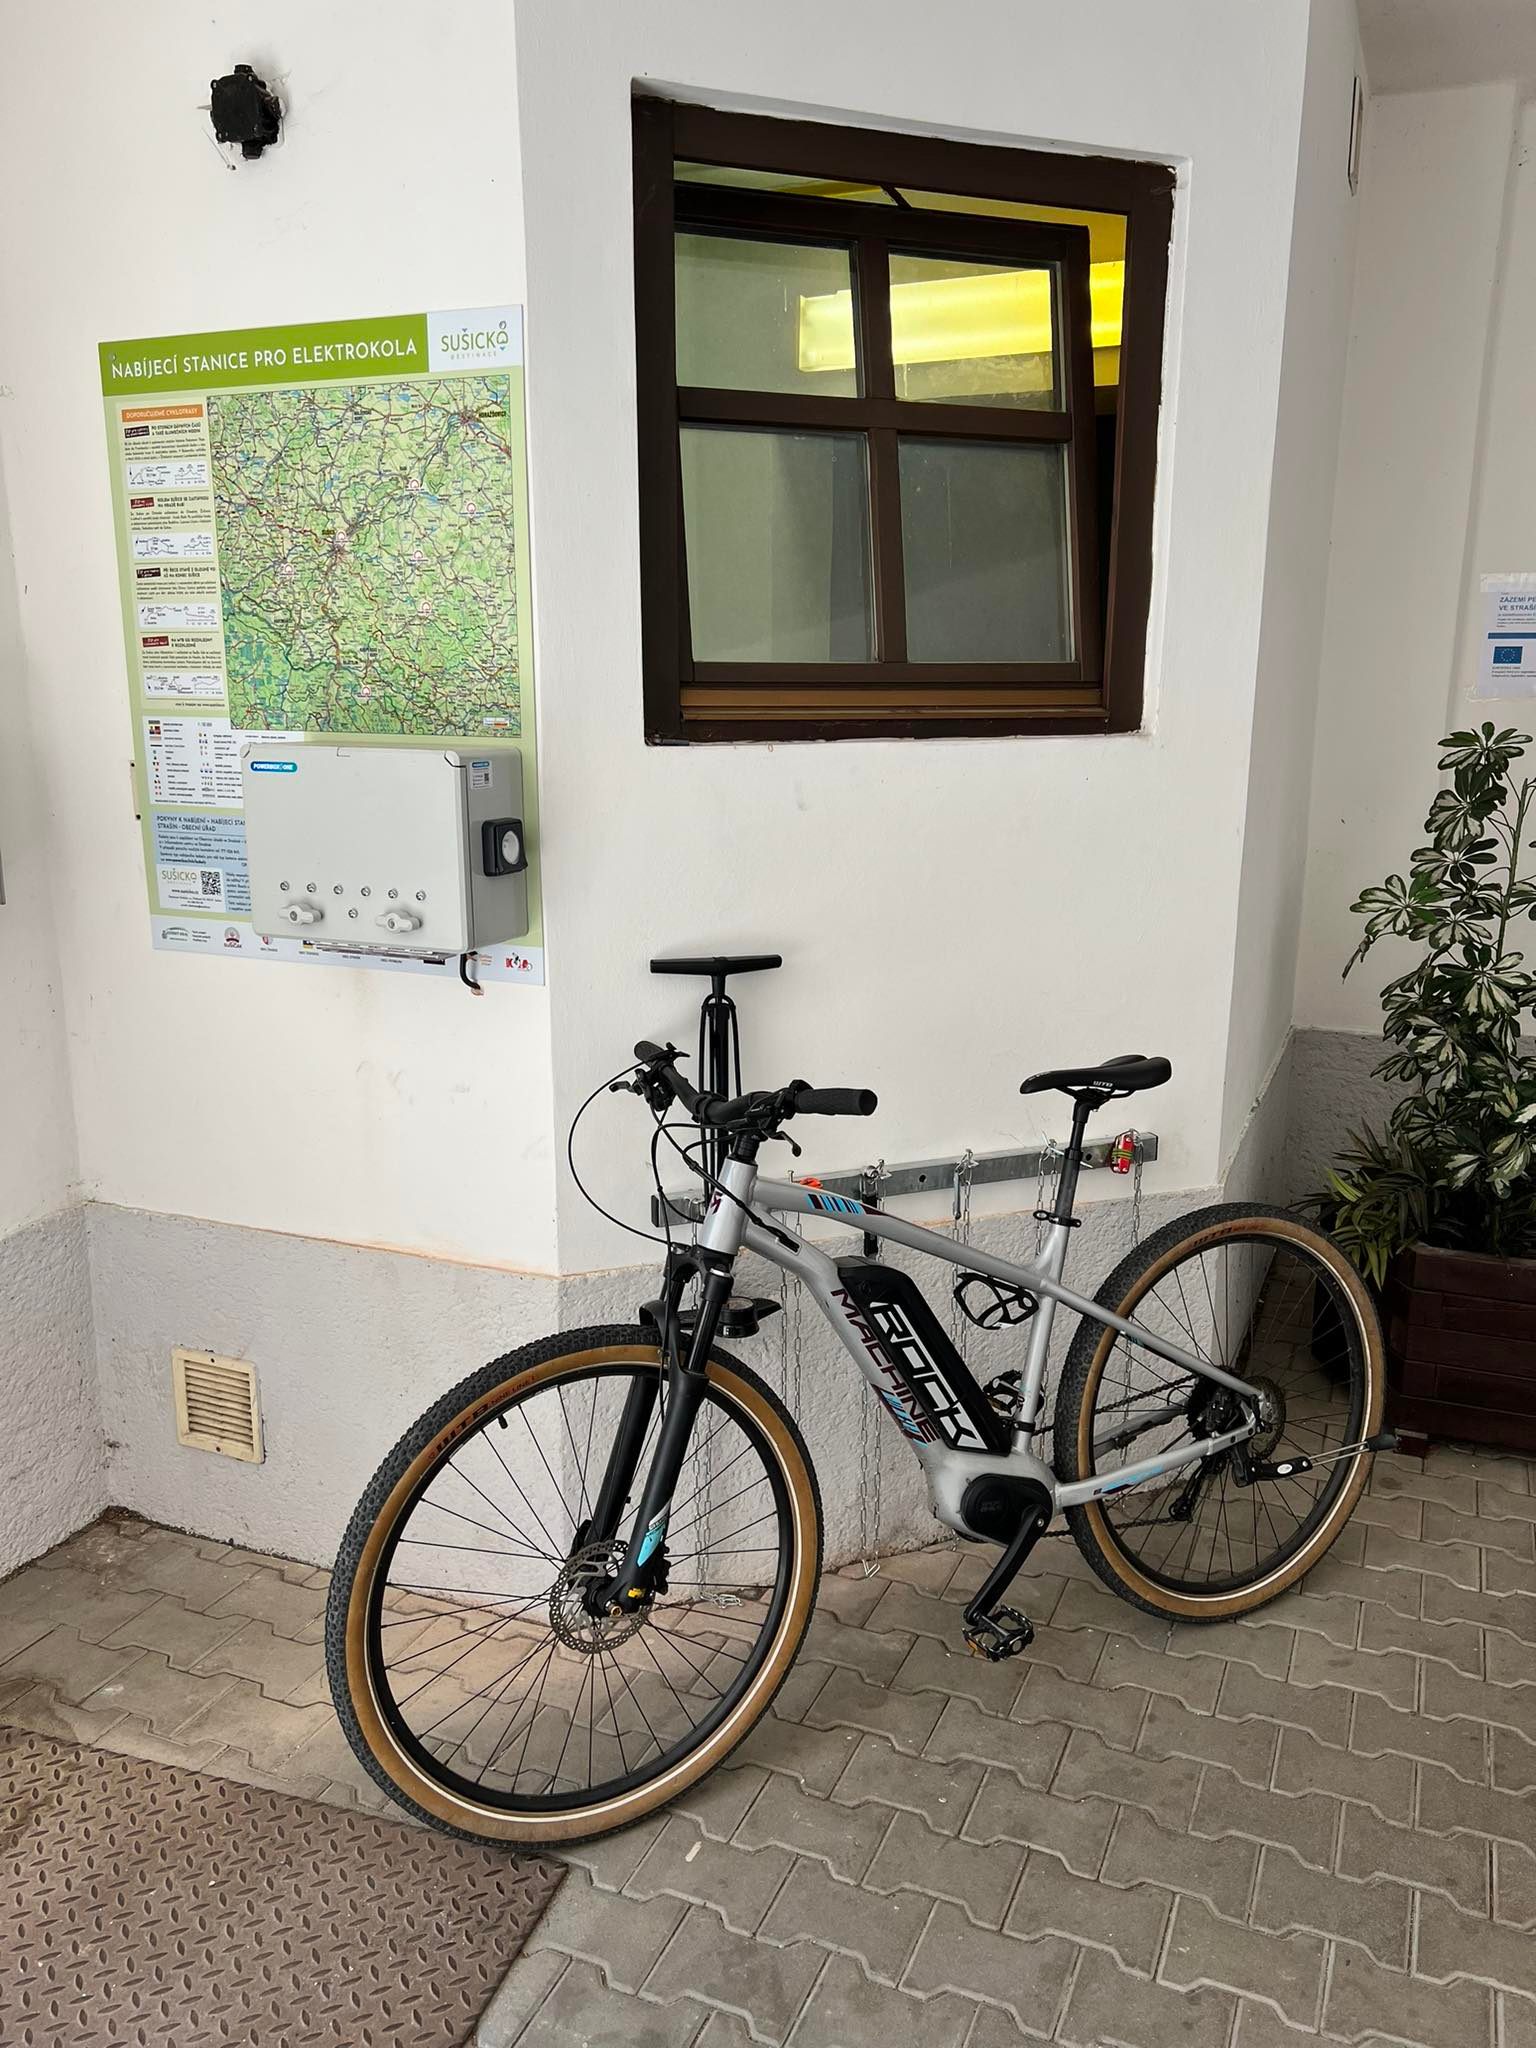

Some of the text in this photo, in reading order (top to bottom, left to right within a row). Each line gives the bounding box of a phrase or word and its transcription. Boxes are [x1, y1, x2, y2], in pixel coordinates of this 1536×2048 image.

[112, 338, 417, 379] NABÍJECÍ STANICE PRO ELEKTROKOLA
[830, 1288, 941, 1444] MACHINE
[869, 1301, 989, 1450] ROCK
